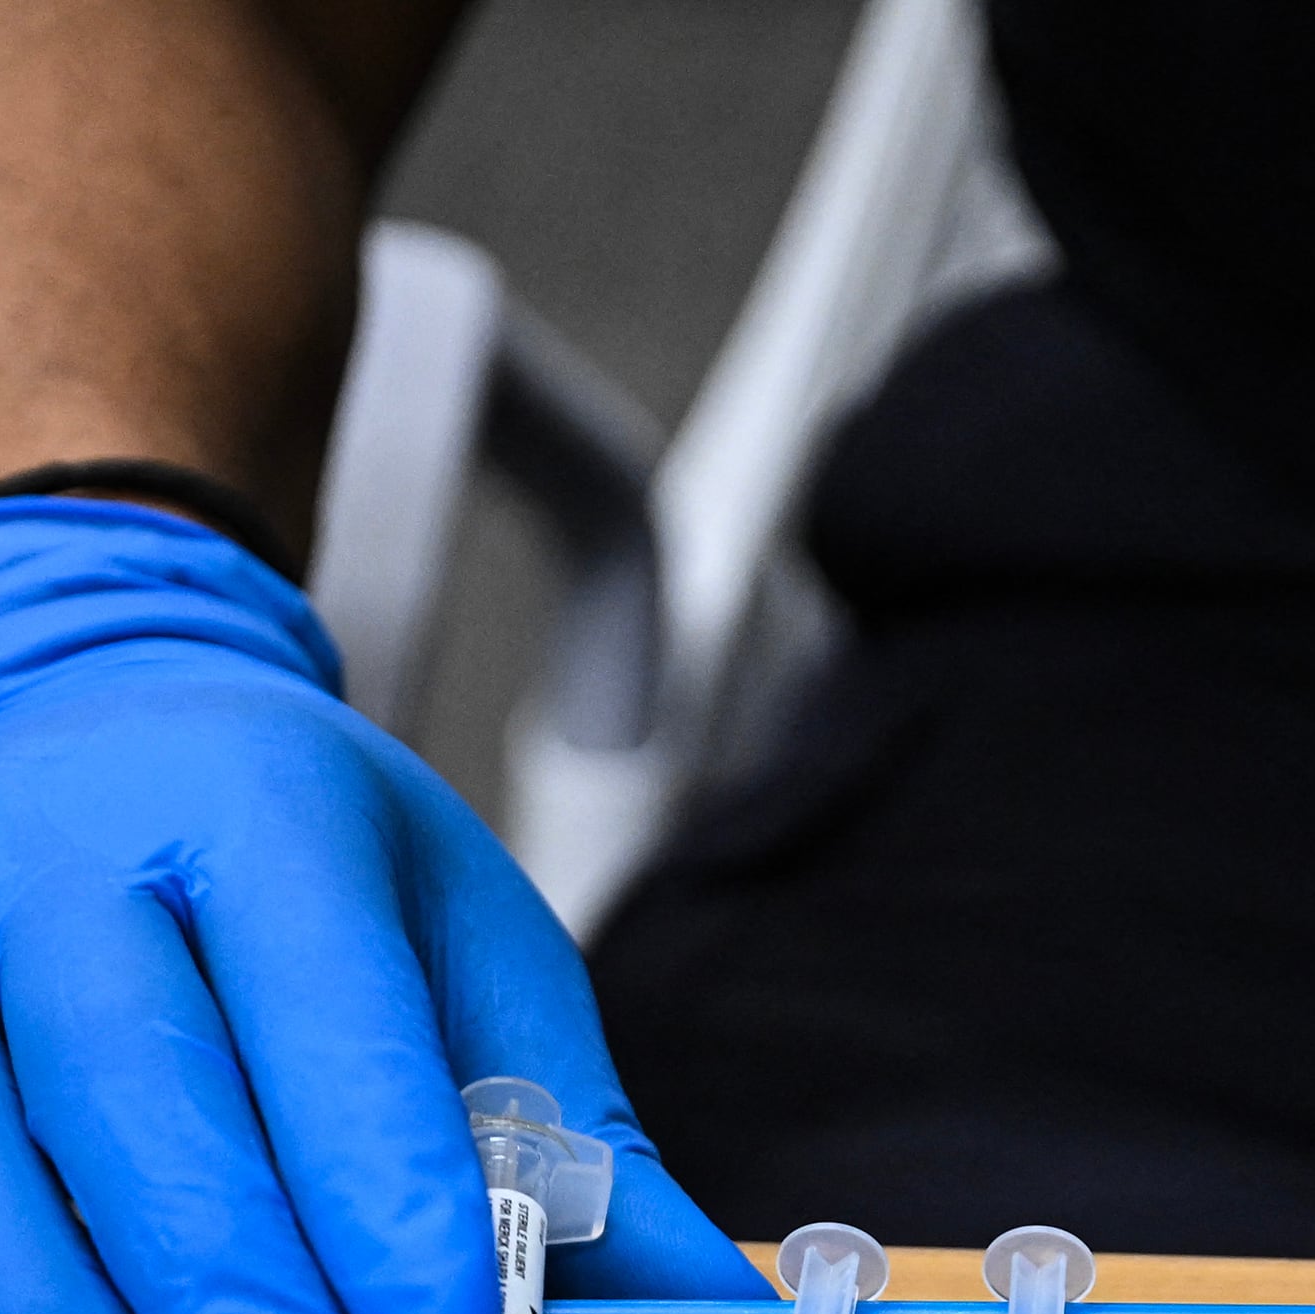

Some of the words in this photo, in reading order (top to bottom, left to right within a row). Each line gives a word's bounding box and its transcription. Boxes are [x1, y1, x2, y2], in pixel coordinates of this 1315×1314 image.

[499, 1198, 512, 1216] FOR
[517, 1202, 529, 1240] STERILE
[515, 1241, 527, 1280] DILUENT
